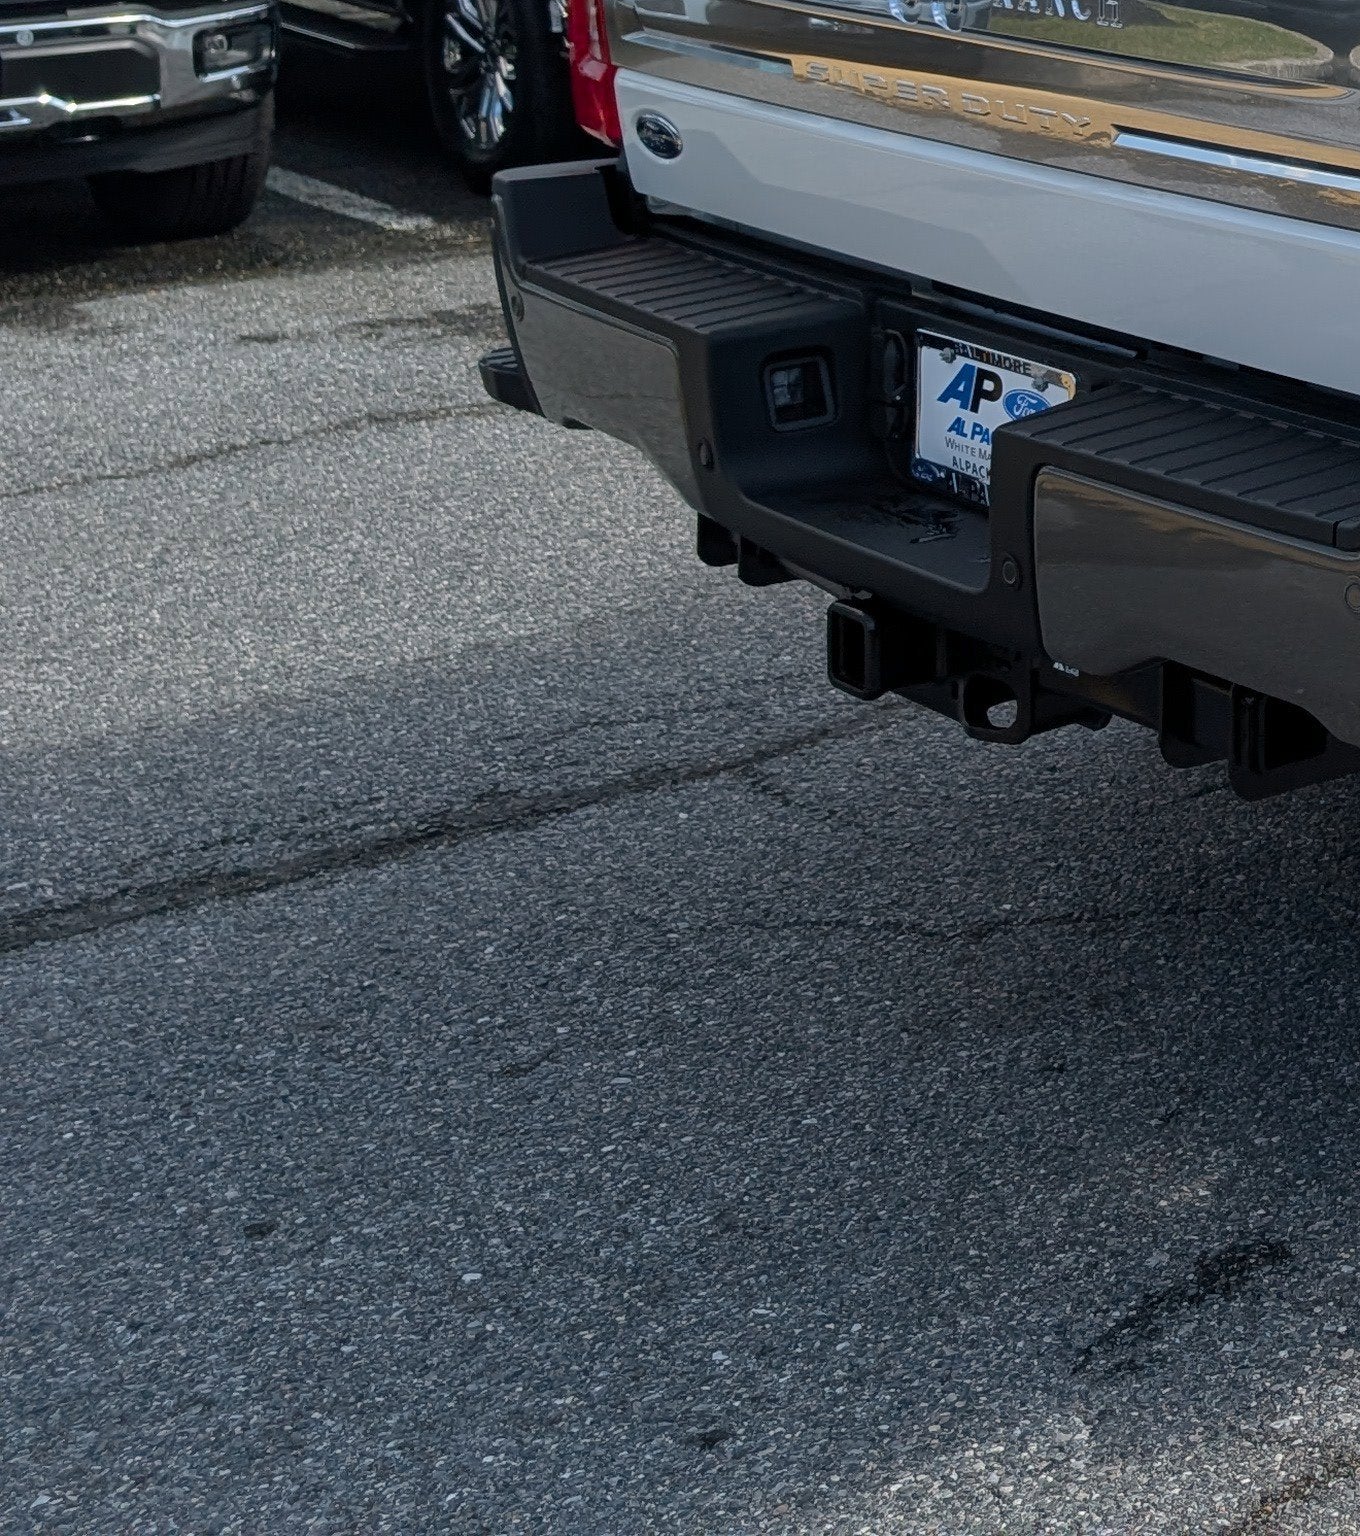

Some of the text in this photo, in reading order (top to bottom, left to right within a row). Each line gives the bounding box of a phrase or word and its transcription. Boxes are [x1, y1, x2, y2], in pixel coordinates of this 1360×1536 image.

[805, 61, 1091, 136] SUPER DUTY
[937, 363, 1003, 414] AP
[971, 421, 991, 446] PA
